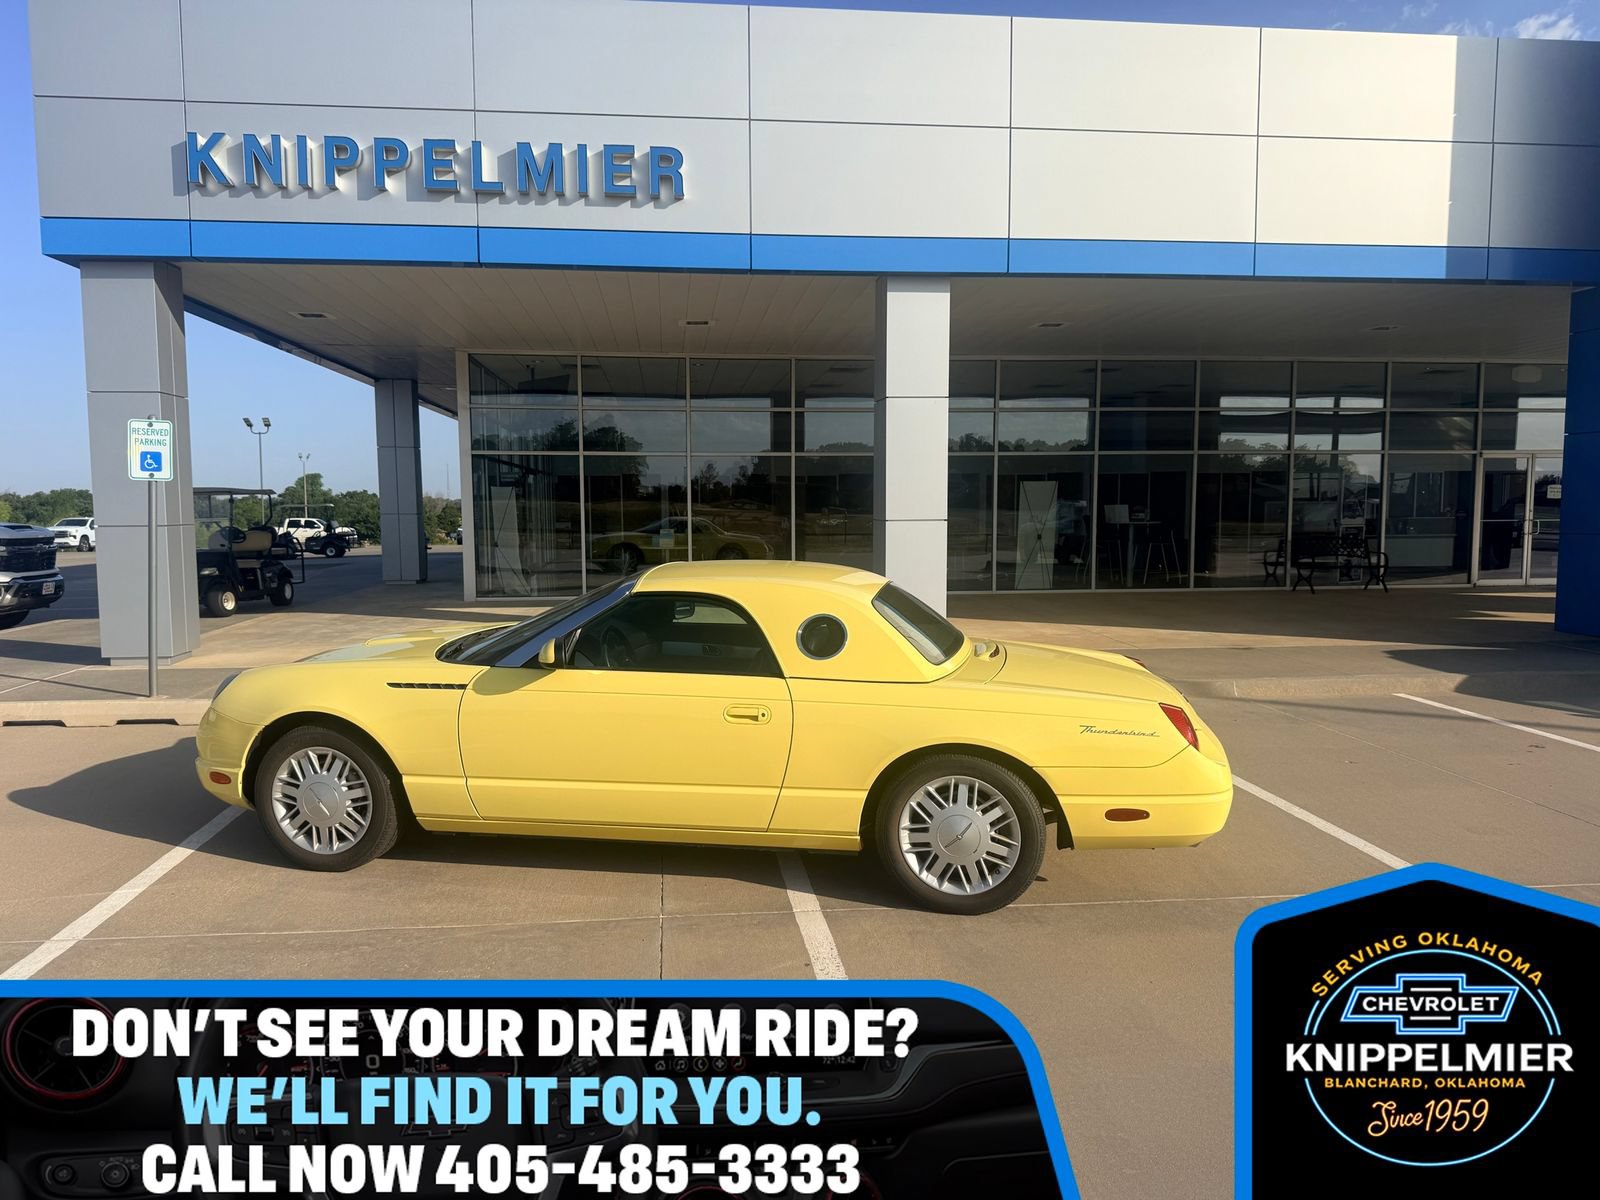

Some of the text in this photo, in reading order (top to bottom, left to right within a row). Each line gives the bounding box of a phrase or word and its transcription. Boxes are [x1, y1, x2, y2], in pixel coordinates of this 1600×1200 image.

[185, 130, 687, 200] KNIPPELMIER
[131, 427, 169, 437] RESERVED
[134, 437, 167, 447] PARKING
[1079, 724, 1160, 738] Thunderbird
